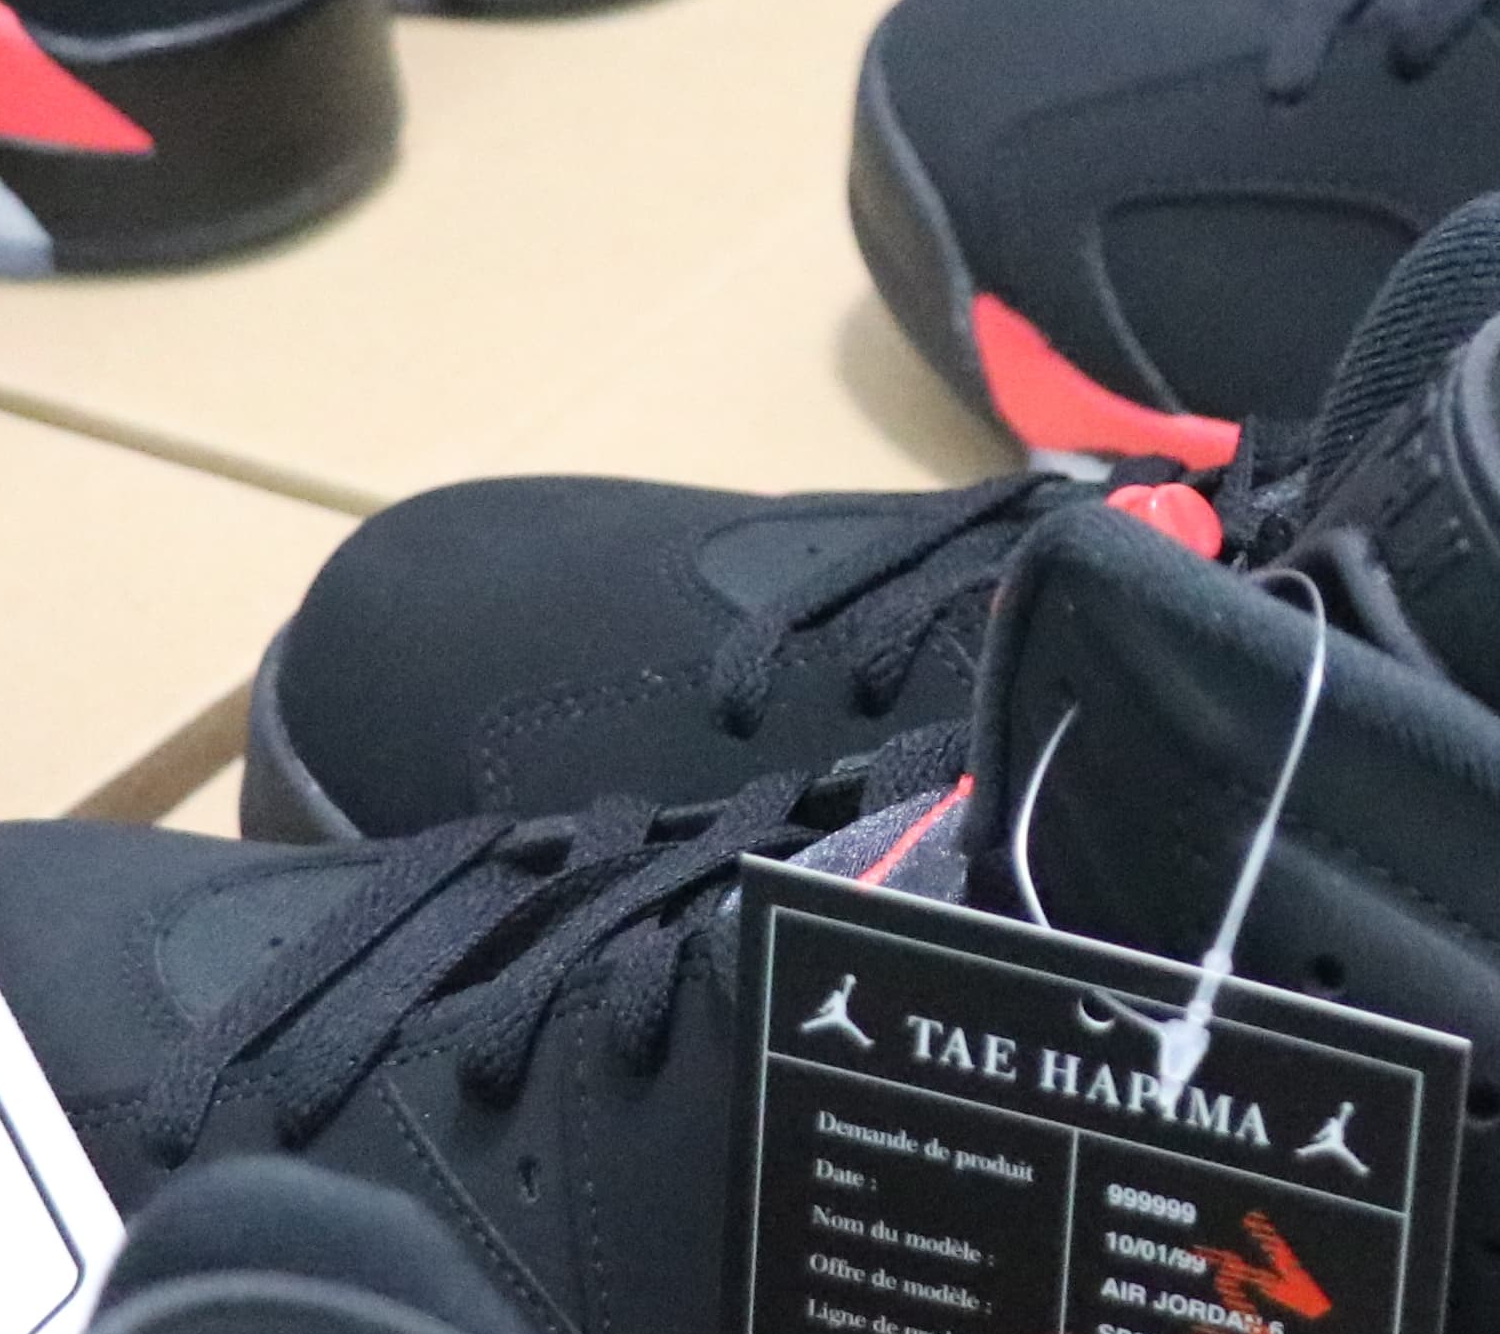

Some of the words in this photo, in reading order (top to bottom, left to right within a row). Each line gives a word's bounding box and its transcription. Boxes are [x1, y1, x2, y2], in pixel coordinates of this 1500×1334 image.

[906, 1013, 1018, 1080] TAE
[816, 1110, 918, 1153] Demande
[924, 1138, 950, 1159] de
[954, 1149, 1034, 1182] produit
[1107, 1183, 1197, 1224] 999999
[812, 1204, 865, 1234] Nom
[870, 1219, 899, 1243] du
[904, 1231, 982, 1264] modèle
[1105, 1231, 1207, 1275] 10/01/99
[809, 1252, 866, 1282] Offre
[871, 1269, 899, 1290] de
[903, 1279, 981, 1311] modèle
[1101, 1277, 1147, 1306] AIR
[1153, 1291, 1263, 1334] JORDAN
[807, 1298, 867, 1329] Ligne
